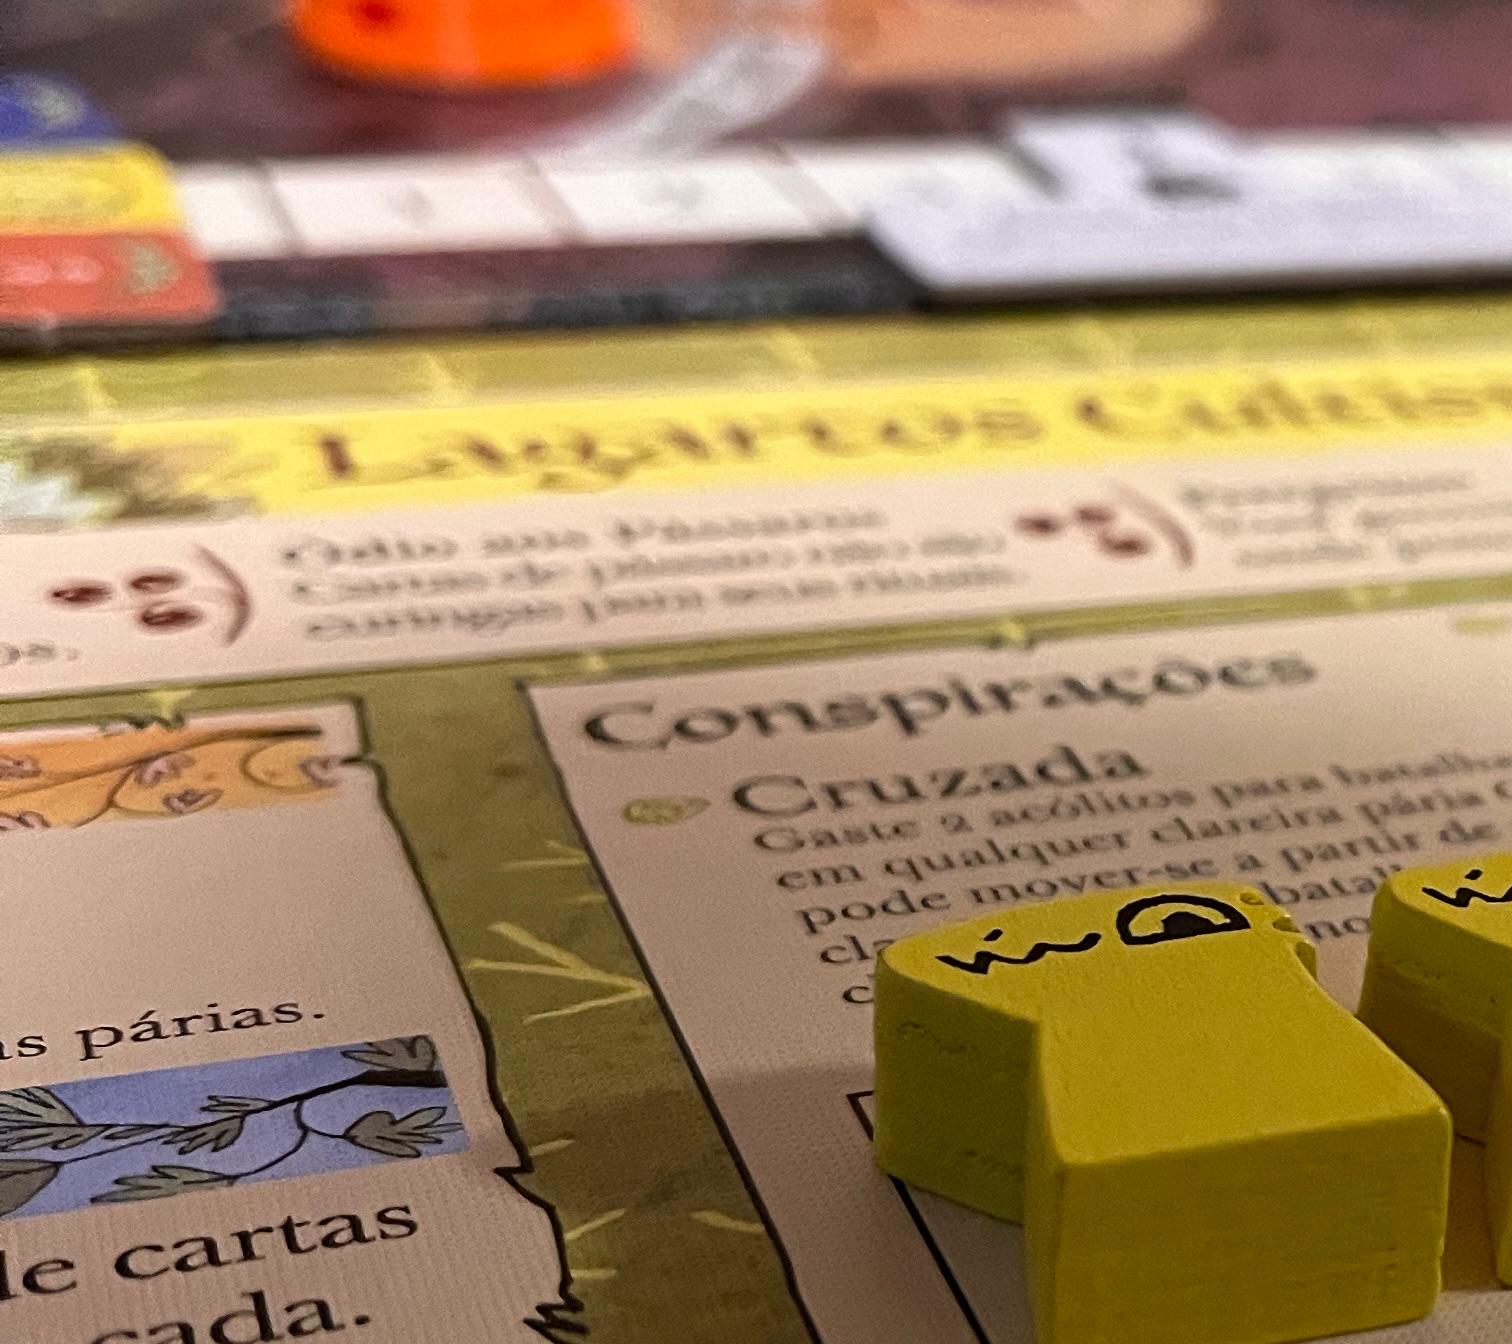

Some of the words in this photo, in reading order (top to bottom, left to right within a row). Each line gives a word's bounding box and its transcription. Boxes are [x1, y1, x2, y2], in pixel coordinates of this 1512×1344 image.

[584, 652, 1318, 752] Conspirações
[732, 744, 1150, 818] Cruzada
[753, 808, 917, 853] Gaste
[940, 812, 973, 834] 2
[992, 786, 1198, 827] acólitos
[1212, 771, 1324, 811] para
[777, 862, 865, 892] em
[884, 828, 1132, 886] qualquer
[1151, 801, 1344, 846] clareira
[1357, 784, 1484, 828] pária
[795, 876, 952, 937] pode
[970, 855, 1220, 908] mover-se
[1280, 829, 1425, 876] partir
[1440, 817, 1500, 846] de
[75, 1002, 325, 1062] párias.
[113, 1200, 420, 1284] cartas
